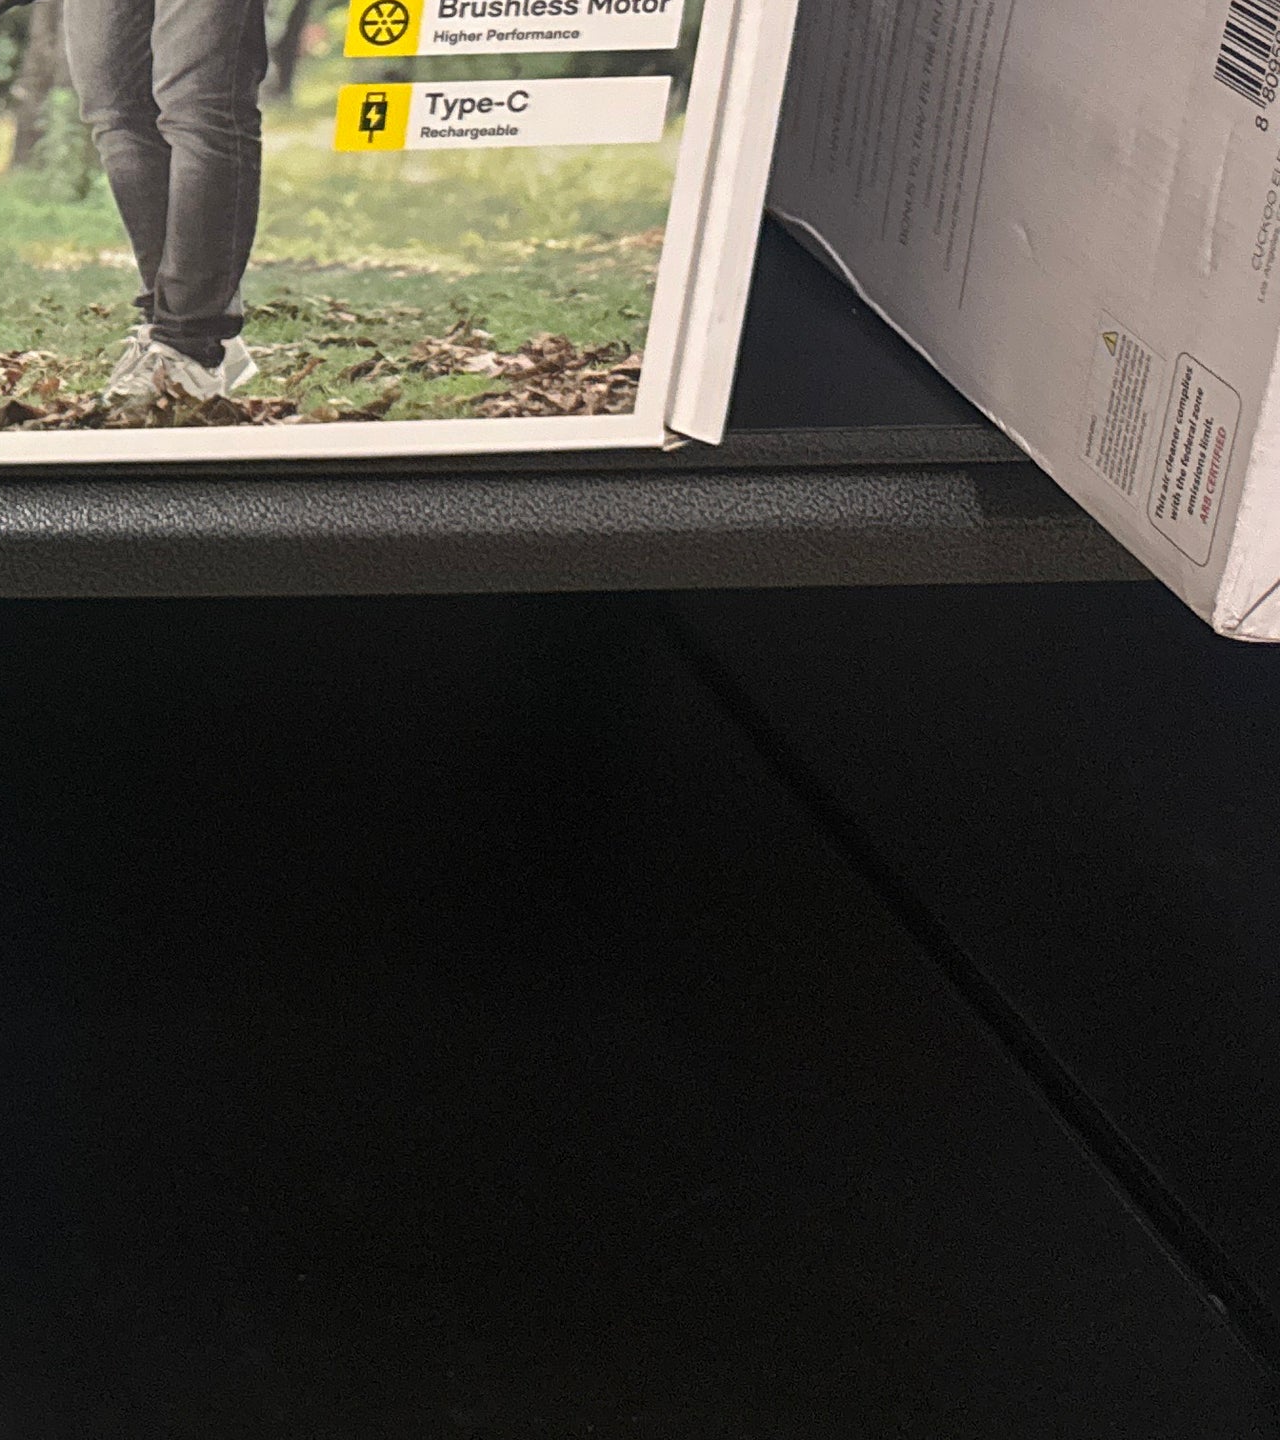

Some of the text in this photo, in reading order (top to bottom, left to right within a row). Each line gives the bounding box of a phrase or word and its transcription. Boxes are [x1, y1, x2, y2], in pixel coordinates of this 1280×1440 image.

[433, 27, 581, 46] Higher Performance
[420, 124, 519, 140] Rechargeable
[425, 90, 531, 122] Type-C
[1255, 114, 1269, 132] 8
[1251, 189, 1278, 272] CUCKOO
[1154, 497, 1166, 520] This
[1165, 429, 1181, 473] cleaner
[1176, 365, 1194, 426] complies
[1170, 498, 1181, 522] with
[1180, 420, 1198, 467] federal
[1194, 386, 1205, 420] zone
[1187, 453, 1205, 517] emissions
[1199, 426, 1228, 525] ARB CERTIFIED
